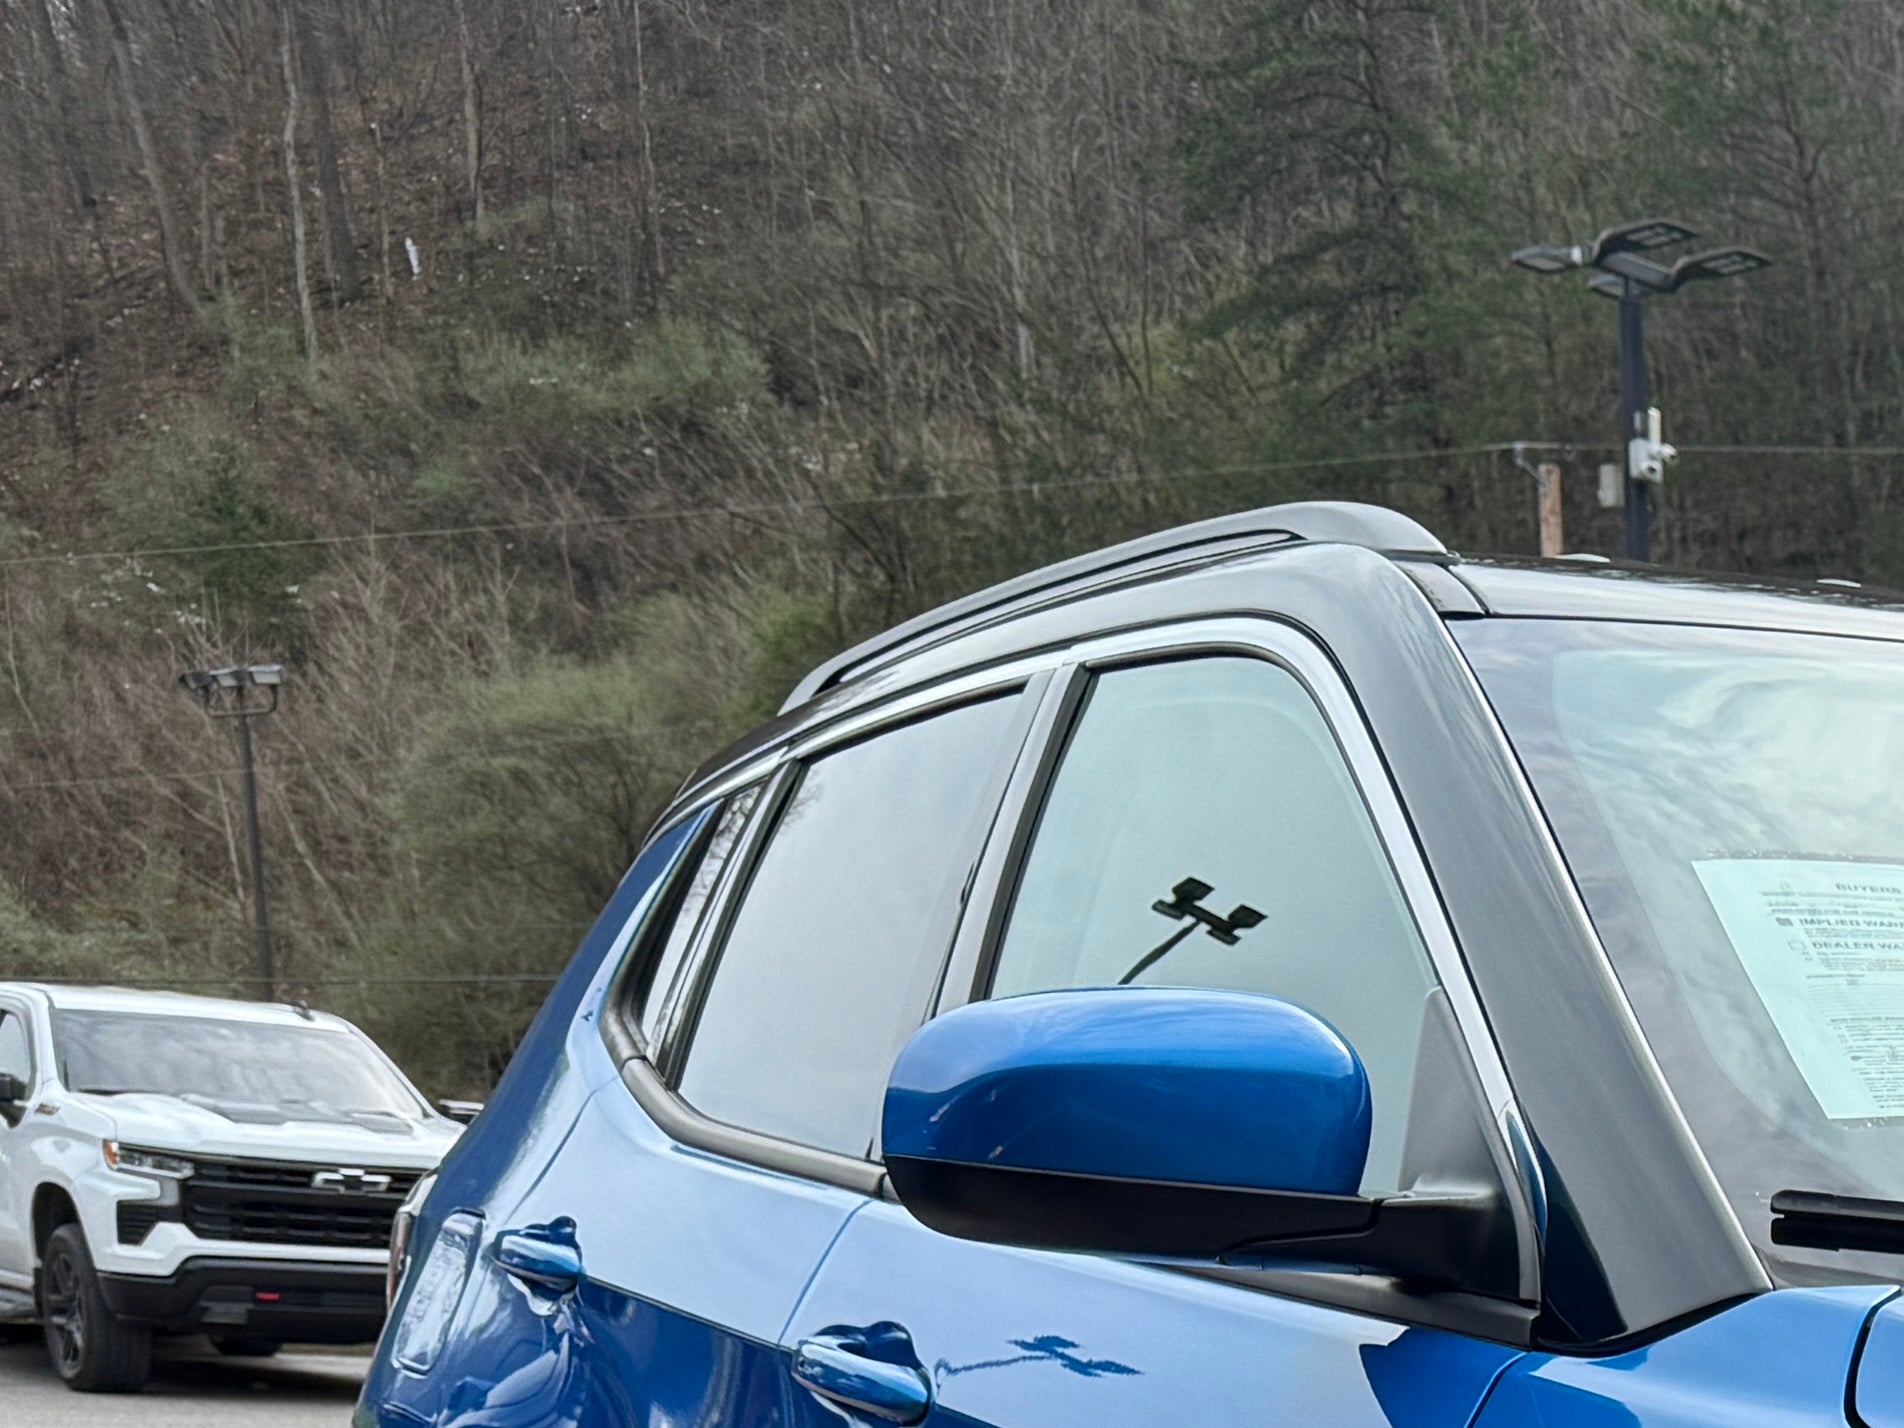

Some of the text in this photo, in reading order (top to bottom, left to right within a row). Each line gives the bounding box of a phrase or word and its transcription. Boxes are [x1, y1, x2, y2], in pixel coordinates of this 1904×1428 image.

[1835, 882, 1901, 895] BUYERS
[1799, 917, 1861, 927] IMPLIED
[1812, 940, 1874, 950] DEALER
